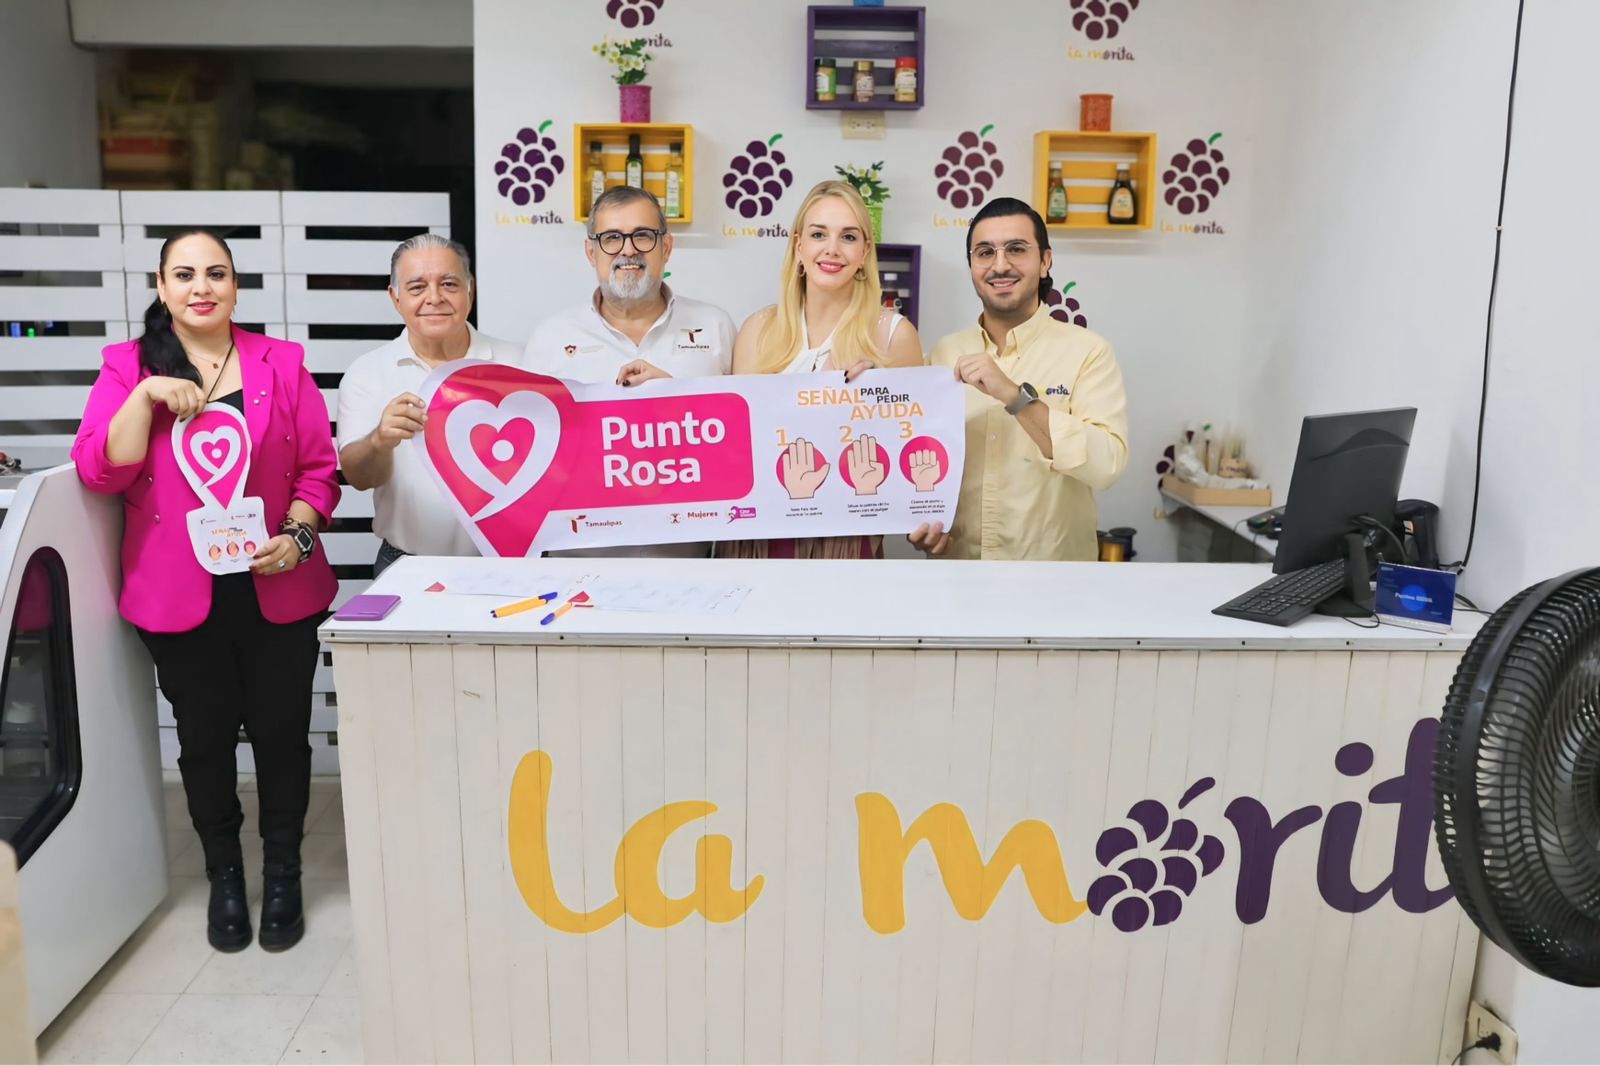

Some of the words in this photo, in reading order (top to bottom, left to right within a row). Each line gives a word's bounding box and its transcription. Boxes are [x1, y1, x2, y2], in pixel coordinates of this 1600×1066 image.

[797, 386, 865, 406] SEÑAL
[860, 386, 890, 397] PARA
[876, 394, 910, 404] PEDIR
[850, 402, 923, 421] AYUDA
[601, 411, 726, 451] Punto
[776, 429, 788, 447] 1
[839, 425, 854, 443] 2
[899, 421, 913, 439] 3
[603, 454, 702, 488] Rosa
[584, 519, 623, 528] Tamaulipas
[686, 510, 718, 519] Mujeres
